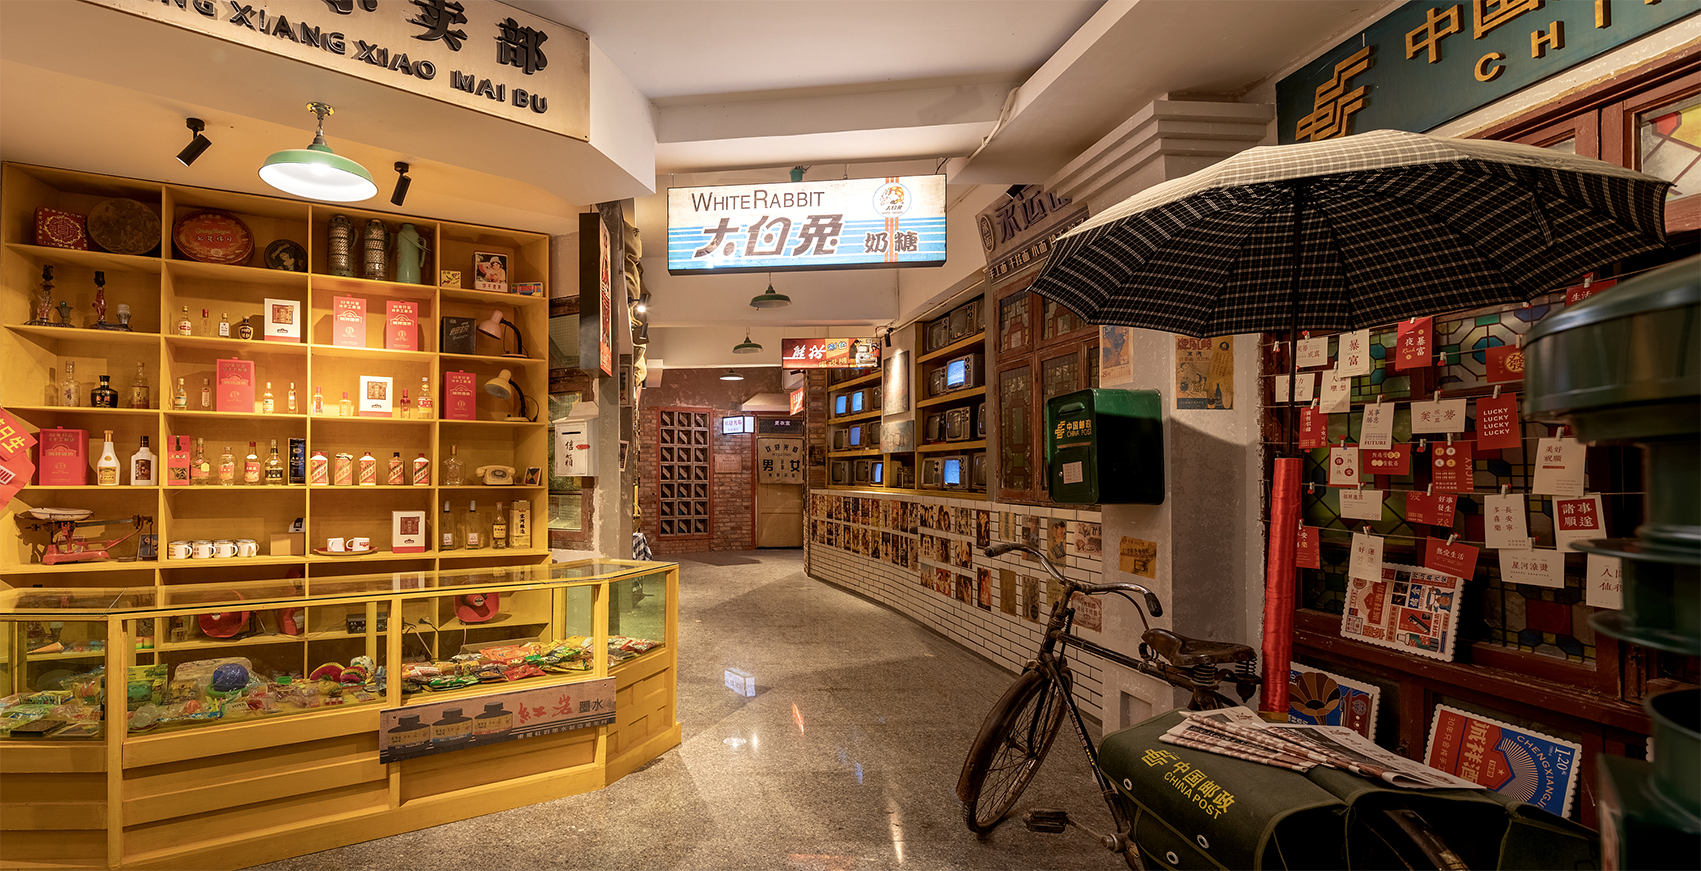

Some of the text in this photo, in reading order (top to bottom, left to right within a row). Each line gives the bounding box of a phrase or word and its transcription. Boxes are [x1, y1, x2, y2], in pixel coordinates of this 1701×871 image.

[327, 0, 548, 75] 卖部
[229, 0, 346, 55] XIANG
[356, 40, 436, 80] XIAO
[451, 70, 506, 102] MAI
[511, 88, 548, 114] BU
[864, 231, 919, 253] 奶糖
[1483, 407, 1509, 416] LUCKY
[1483, 414, 1509, 423] LUCKY
[1066, 419, 1092, 432] 中国邮政
[1484, 421, 1510, 430] LUCKY
[1484, 428, 1511, 437] LUCKY
[565, 439, 574, 467] 信箱
[763, 459, 774, 472] 男
[790, 459, 801, 473] 女
[579, 698, 604, 714] 墨水
[1164, 771, 1222, 820] CHINA POST
[1173, 761, 1235, 814] 中国邮政
